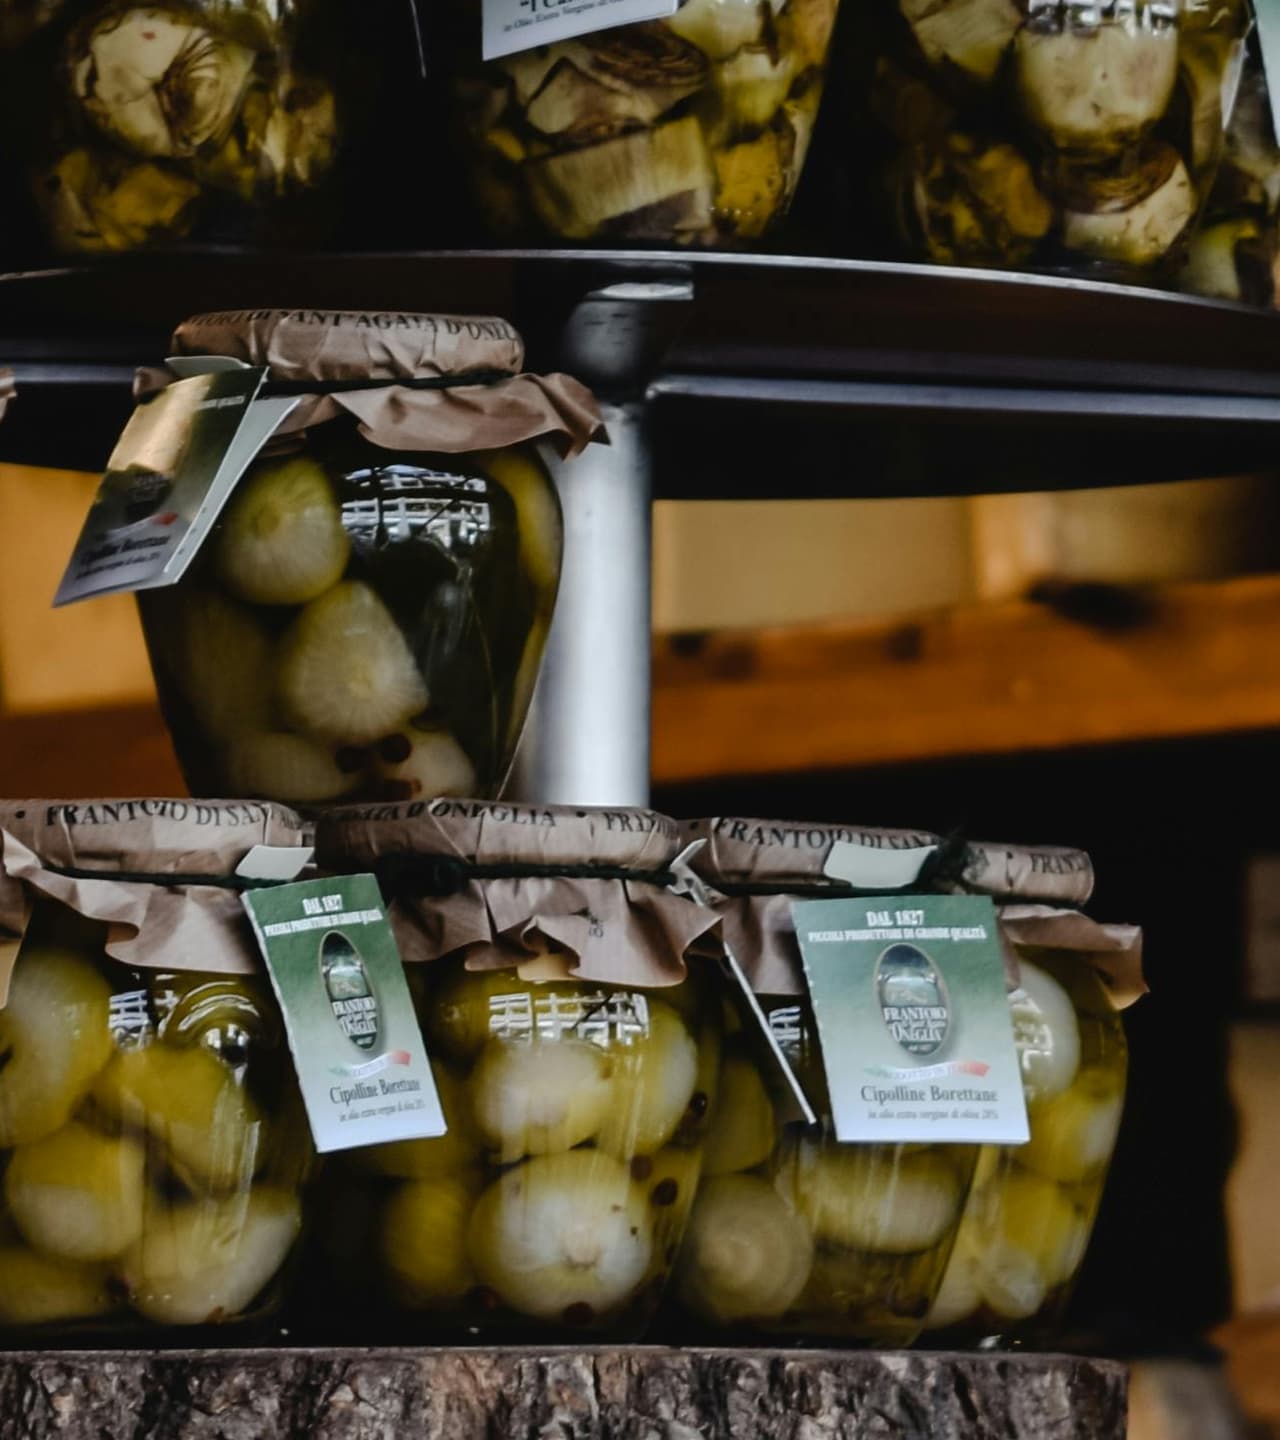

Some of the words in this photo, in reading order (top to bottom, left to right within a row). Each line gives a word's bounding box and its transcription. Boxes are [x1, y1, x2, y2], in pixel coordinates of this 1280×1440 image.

[866, 911, 895, 927] DAL
[894, 909, 925, 927] 1827
[883, 1006, 948, 1021] FRANTOIO
[329, 1082, 379, 1107] Cipolline
[860, 1084, 927, 1107] Cipolline
[929, 1084, 1000, 1103] Borettane
